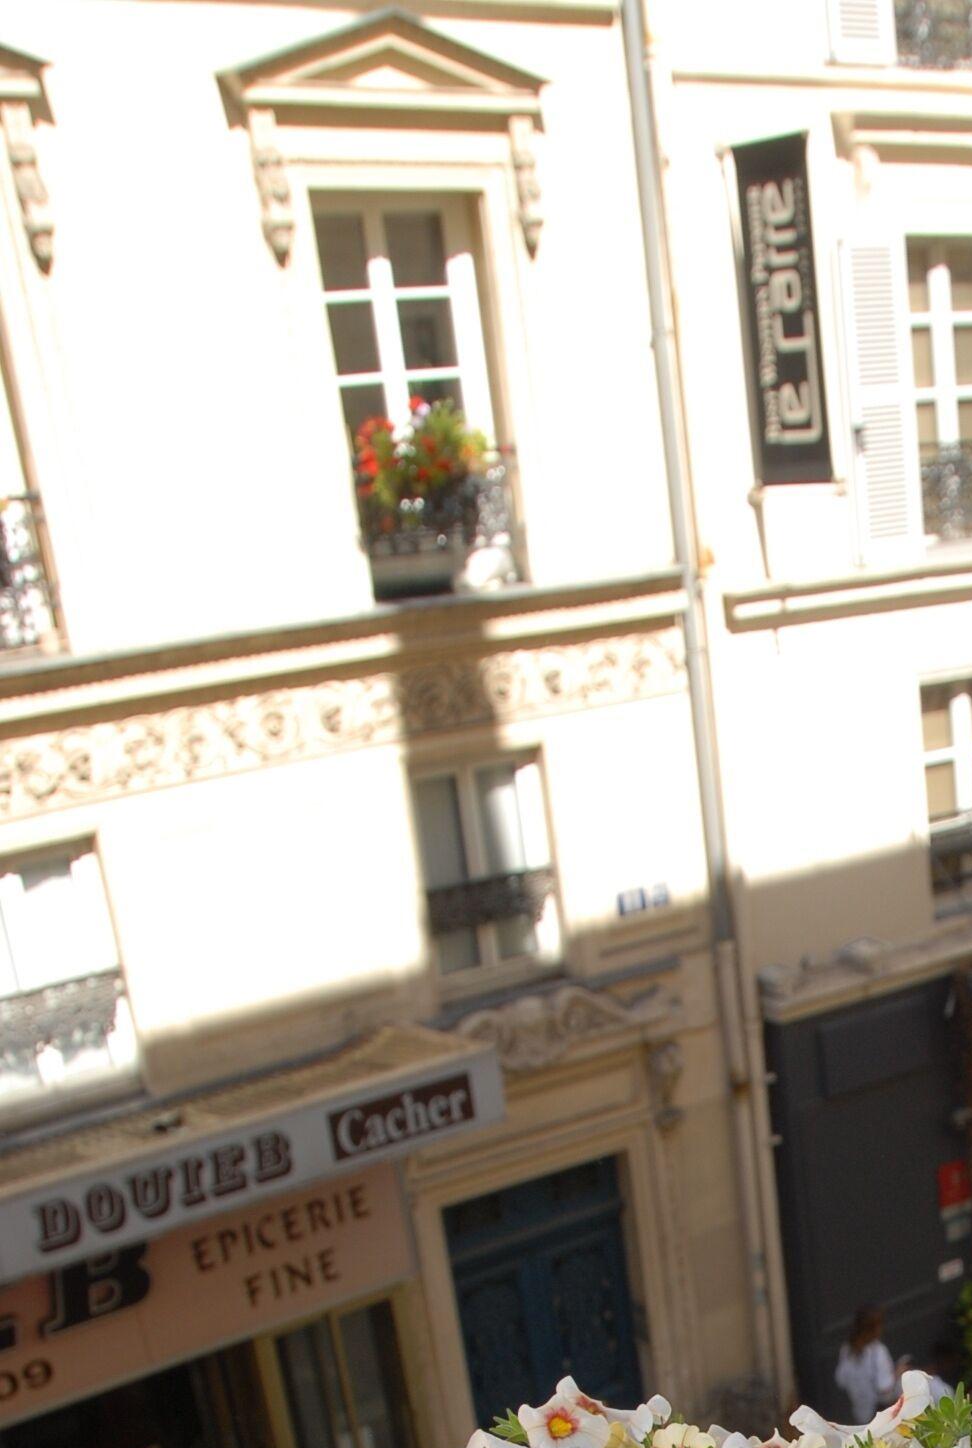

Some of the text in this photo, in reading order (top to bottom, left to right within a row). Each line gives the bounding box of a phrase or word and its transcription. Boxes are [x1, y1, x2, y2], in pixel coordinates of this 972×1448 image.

[336, 1087, 466, 1155] Cacher
[36, 1133, 291, 1251] DOUIEB
[192, 1185, 372, 1272] EPICERIE
[245, 1249, 341, 1307] FINE
